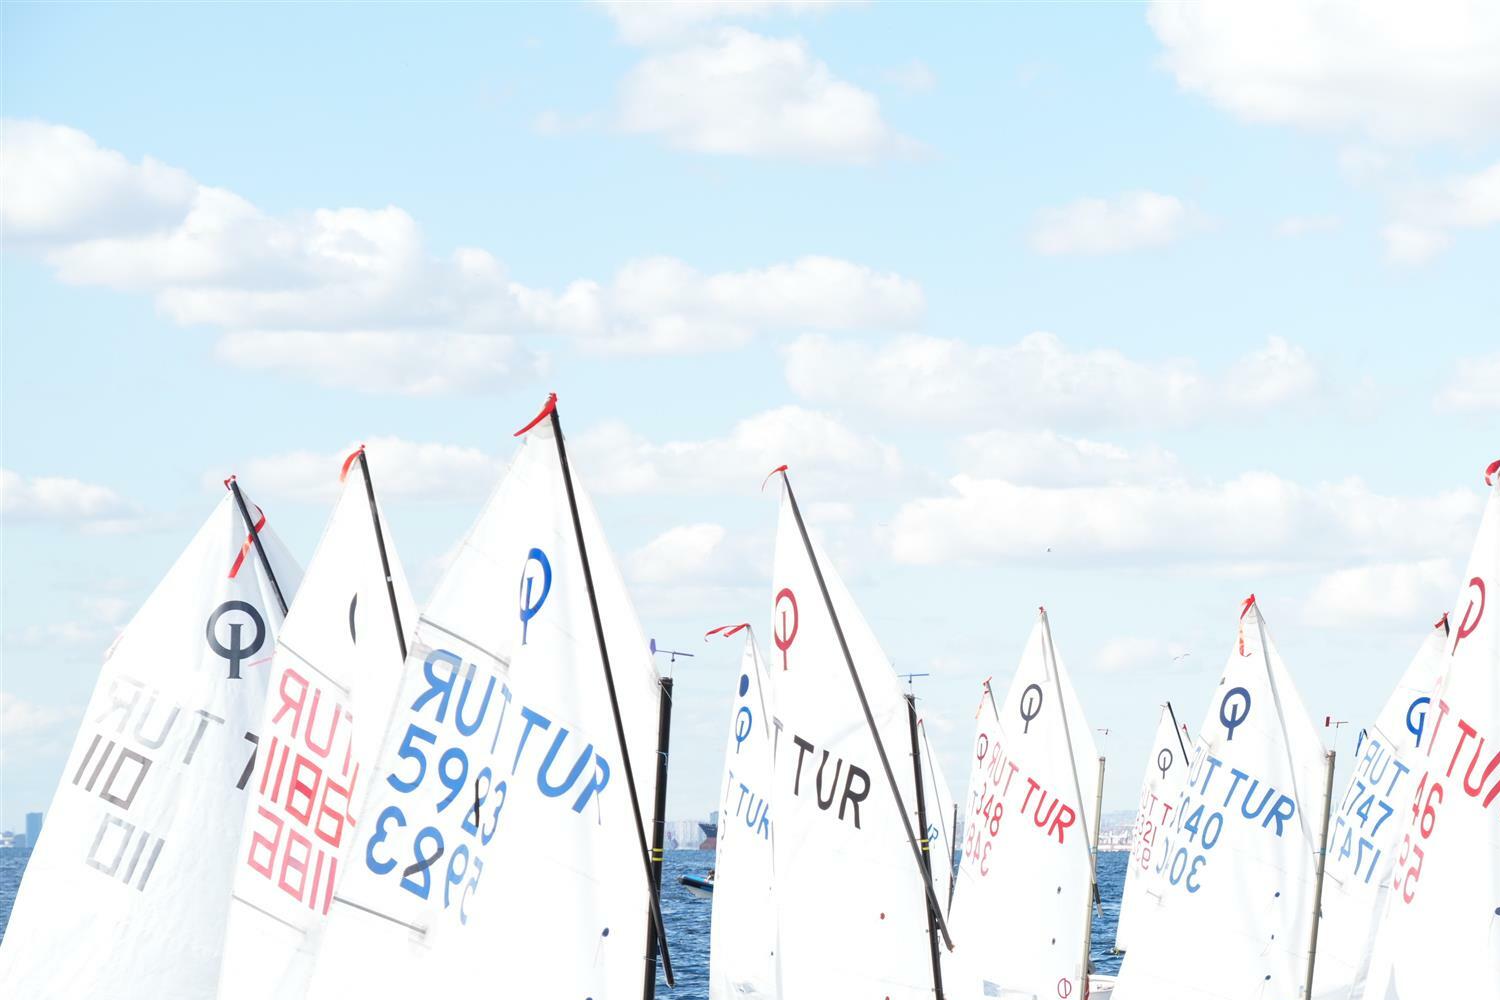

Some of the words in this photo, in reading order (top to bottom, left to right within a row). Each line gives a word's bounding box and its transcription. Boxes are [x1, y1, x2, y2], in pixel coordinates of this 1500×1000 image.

[72, 734, 152, 812] 110
[511, 706, 610, 825] TUR
[793, 735, 870, 830] TUR
[1223, 768, 1295, 837] TUR
[1021, 777, 1076, 844] TUR
